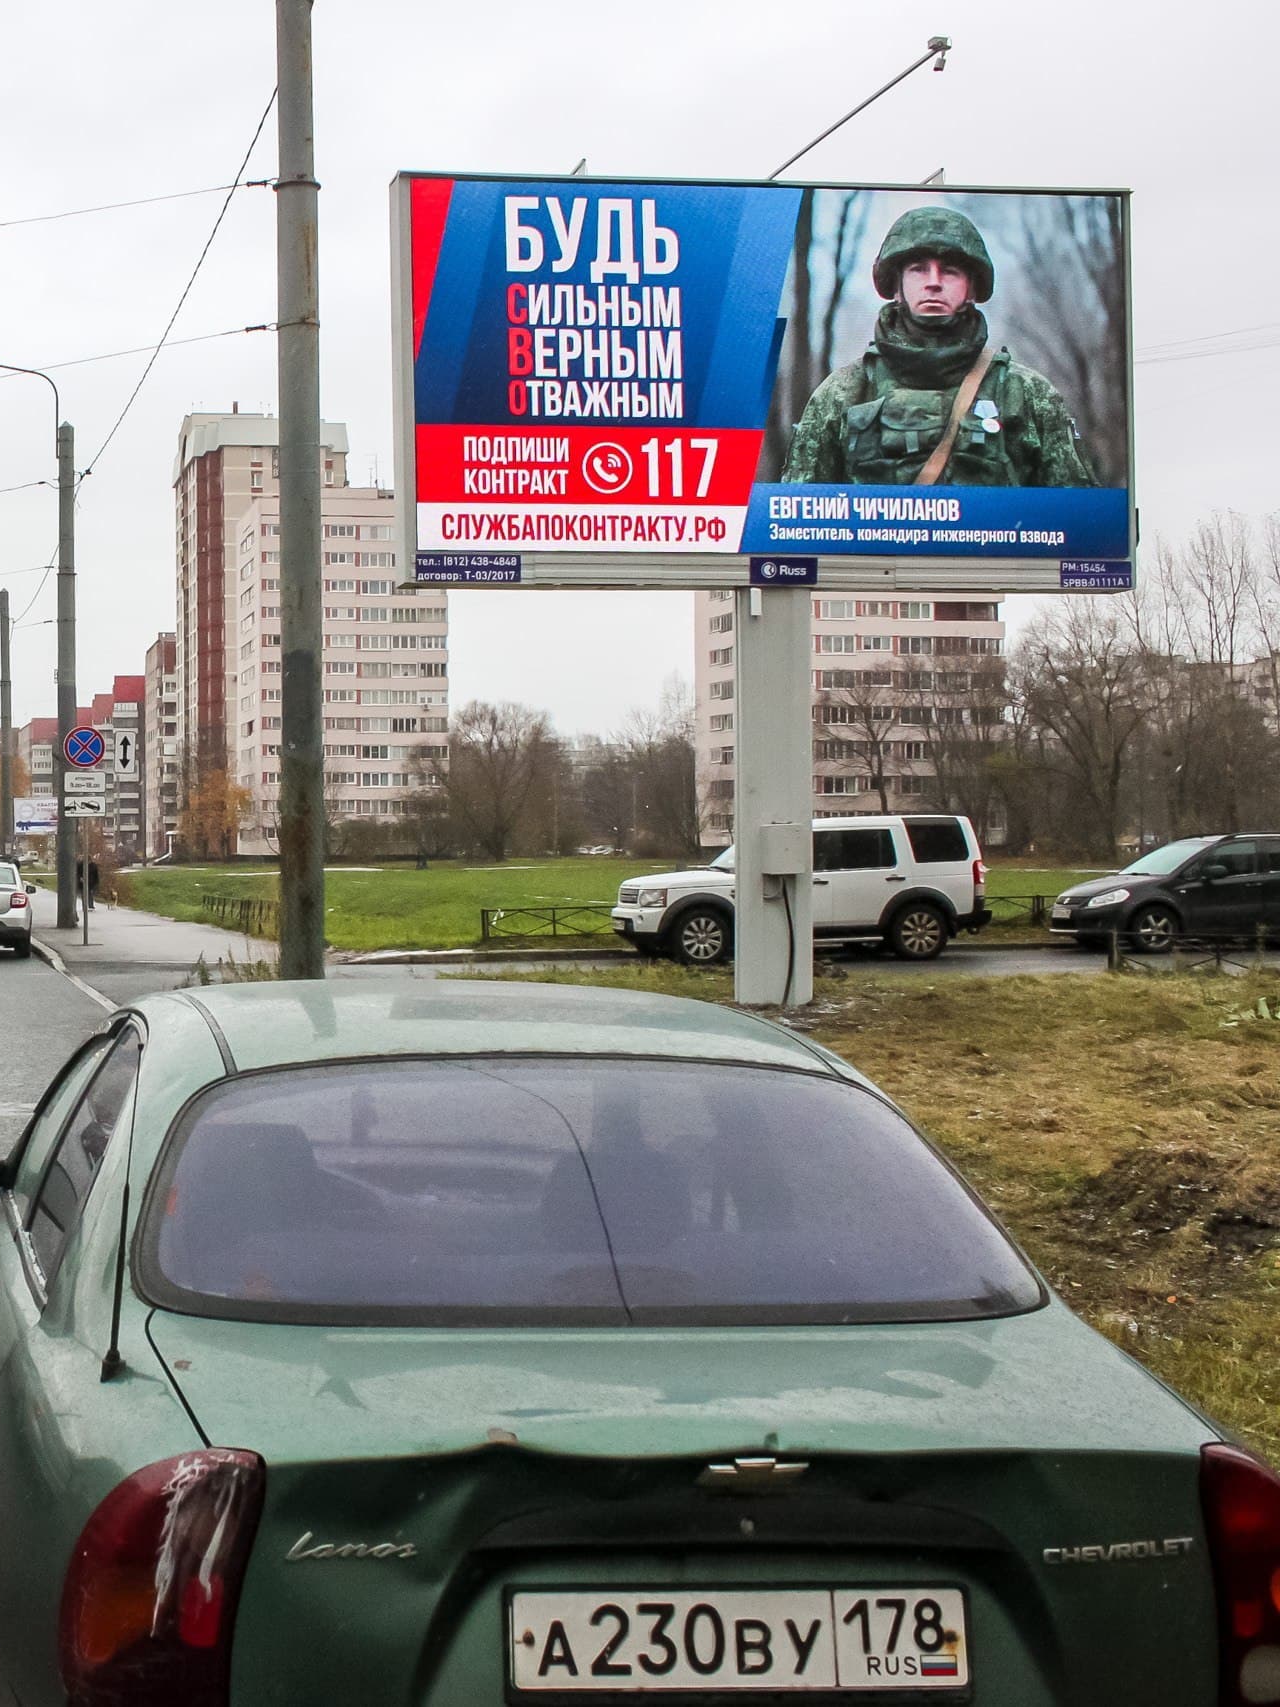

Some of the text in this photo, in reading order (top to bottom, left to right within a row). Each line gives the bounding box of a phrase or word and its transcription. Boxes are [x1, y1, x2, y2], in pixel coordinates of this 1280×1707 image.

[505, 196, 680, 284] БУДЬ
[506, 283, 682, 328] СИЛЬНЫМ
[508, 327, 683, 379] ВЕРНЫМ
[508, 380, 684, 418] ОТВАЖНЫМ
[463, 436, 569, 464] ПОДПИШИ
[463, 469, 569, 495] КОНТРАКТ
[641, 438, 719, 498] 117
[769, 493, 961, 522] ЕВГЕНИЙ ЧИЧИЛАНОВ
[441, 513, 726, 542] СЛУЖБАПОКОНТРАКТУ.РФ
[769, 523, 1065, 546] Заместитель командира инженерного взвода
[470, 556, 517, 566] 438-4848
[779, 565, 807, 576] Russ
[417, 572, 462, 581] договор:
[285, 1531, 419, 1561] Lanos
[1043, 1537, 1194, 1564] CHEVROLET
[843, 1599, 944, 1655] 178
[866, 1655, 918, 1676] RUS
